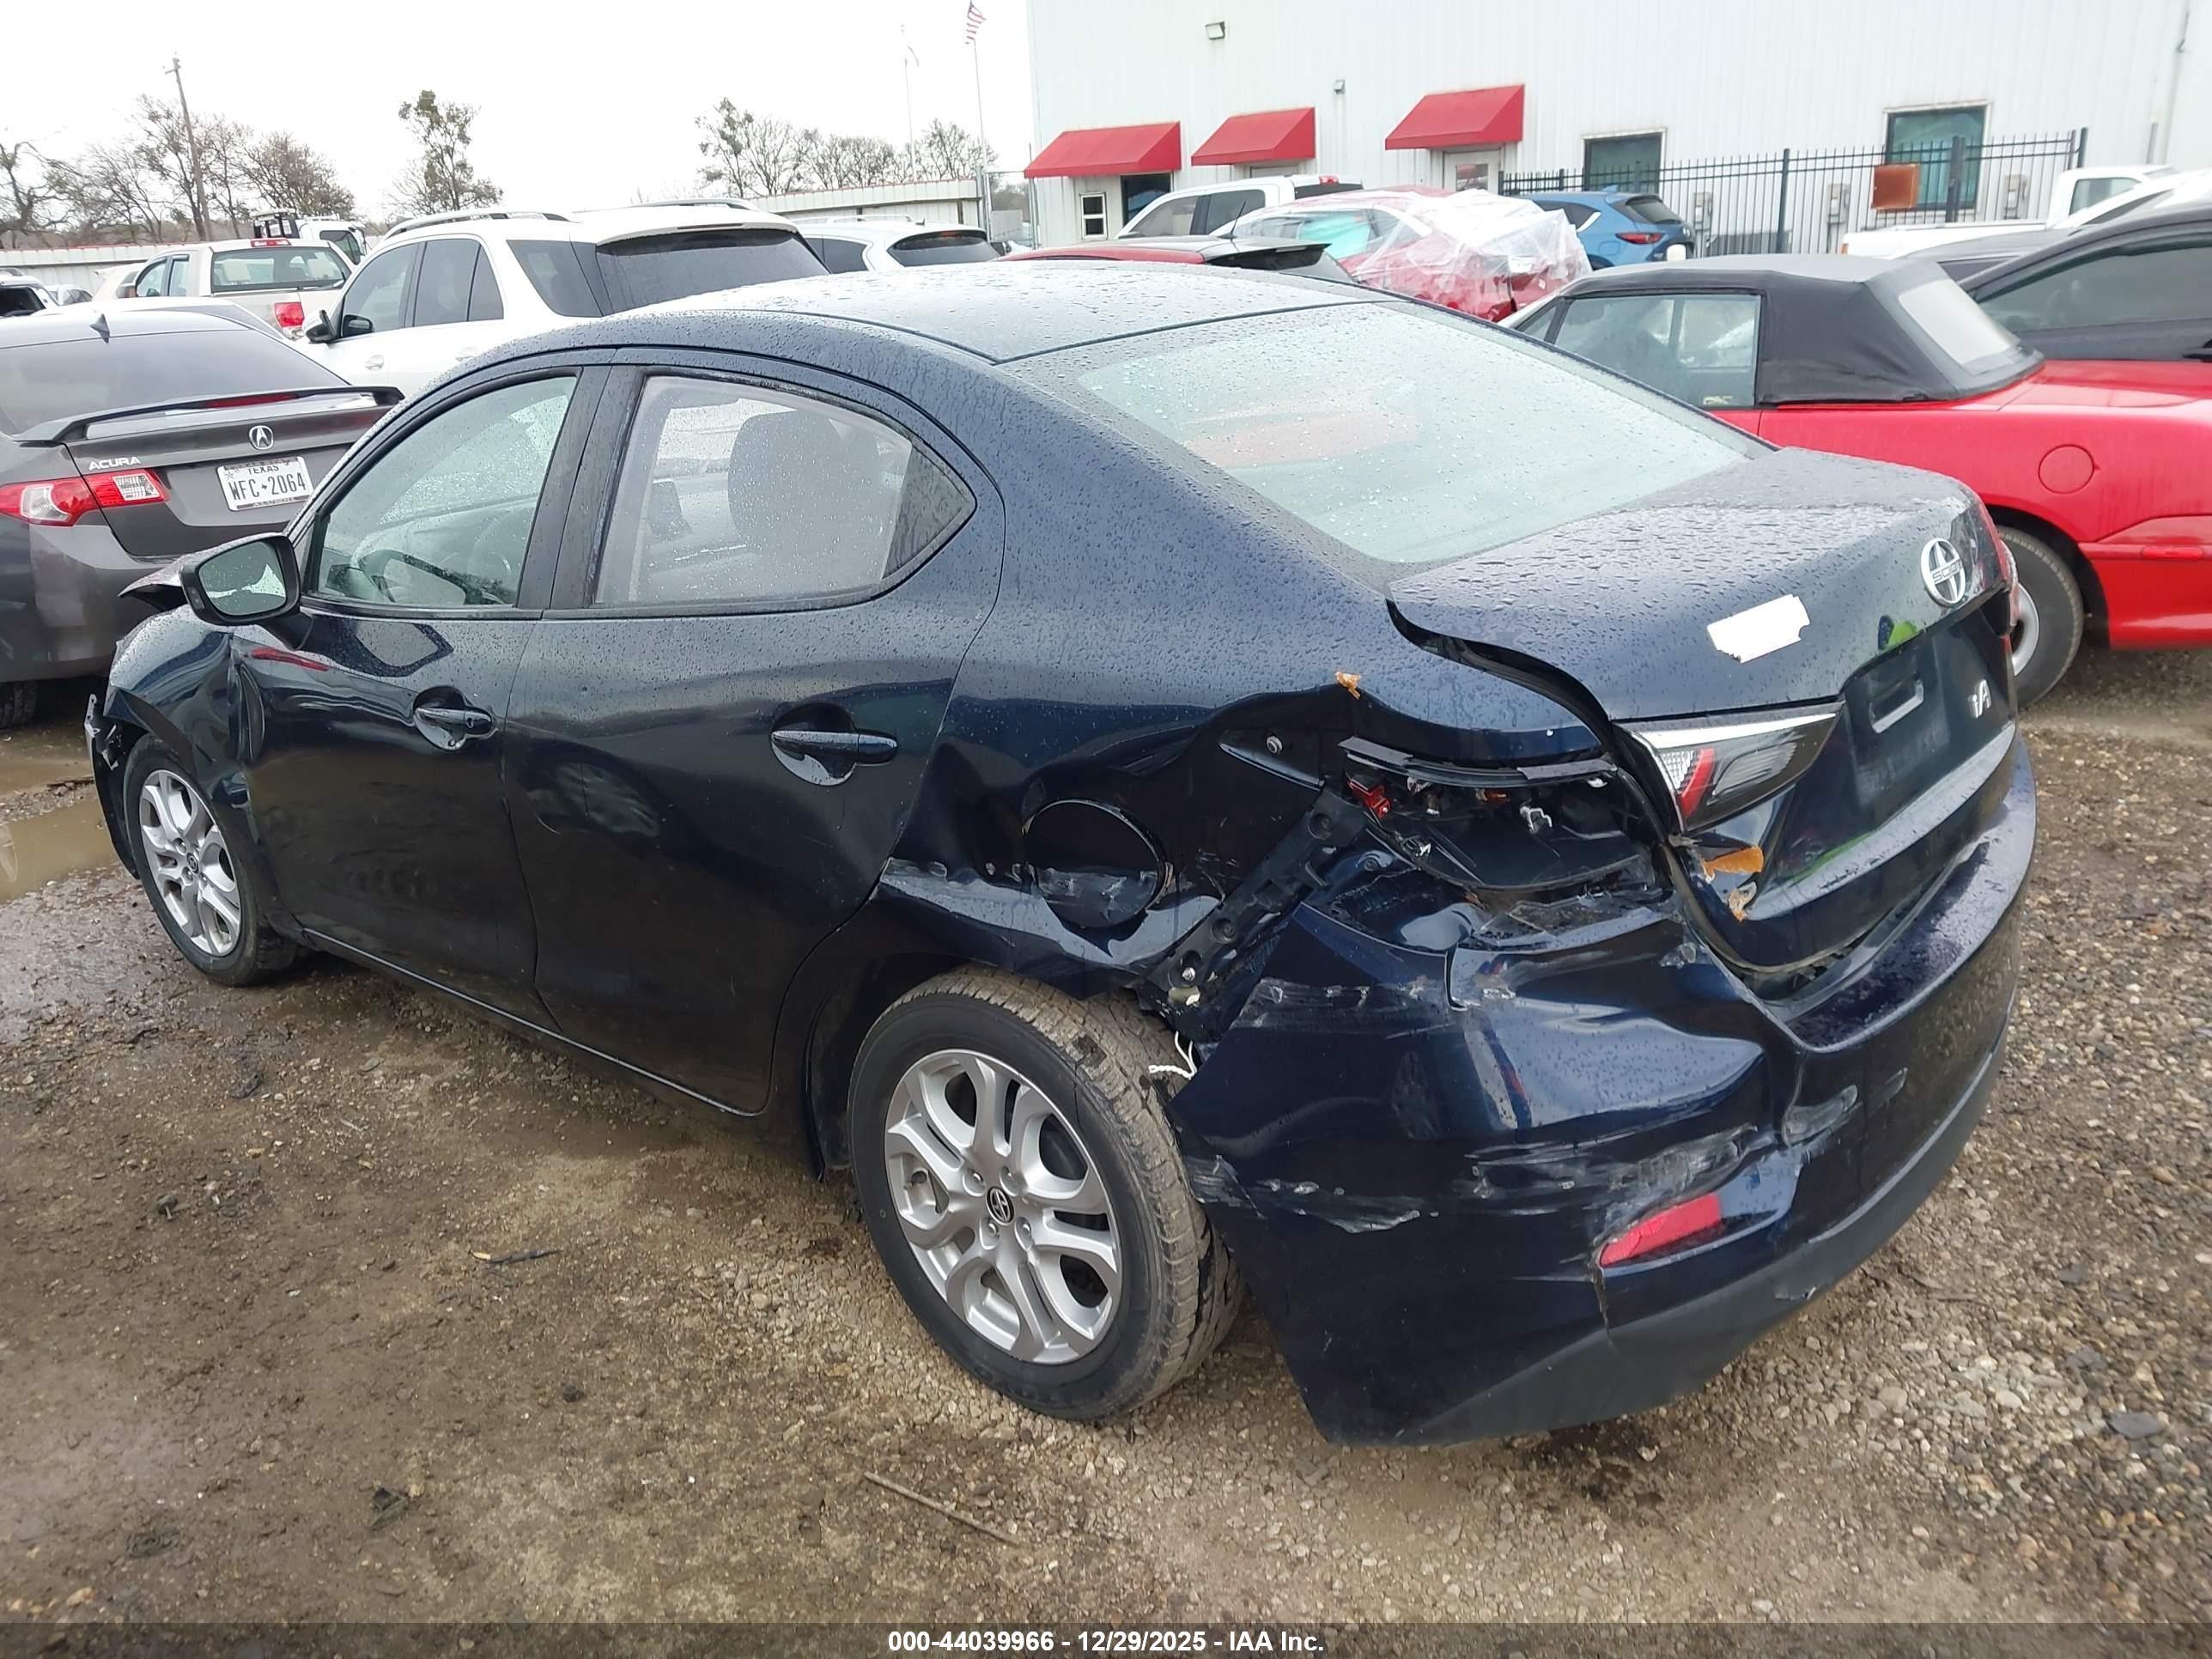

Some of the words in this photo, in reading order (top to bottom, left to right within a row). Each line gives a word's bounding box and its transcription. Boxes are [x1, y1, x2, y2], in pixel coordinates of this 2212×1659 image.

[88, 456, 142, 471] ACURA
[247, 465, 280, 475] TEXAS
[267, 472, 307, 495] 2064
[1971, 678, 1992, 719] iA
